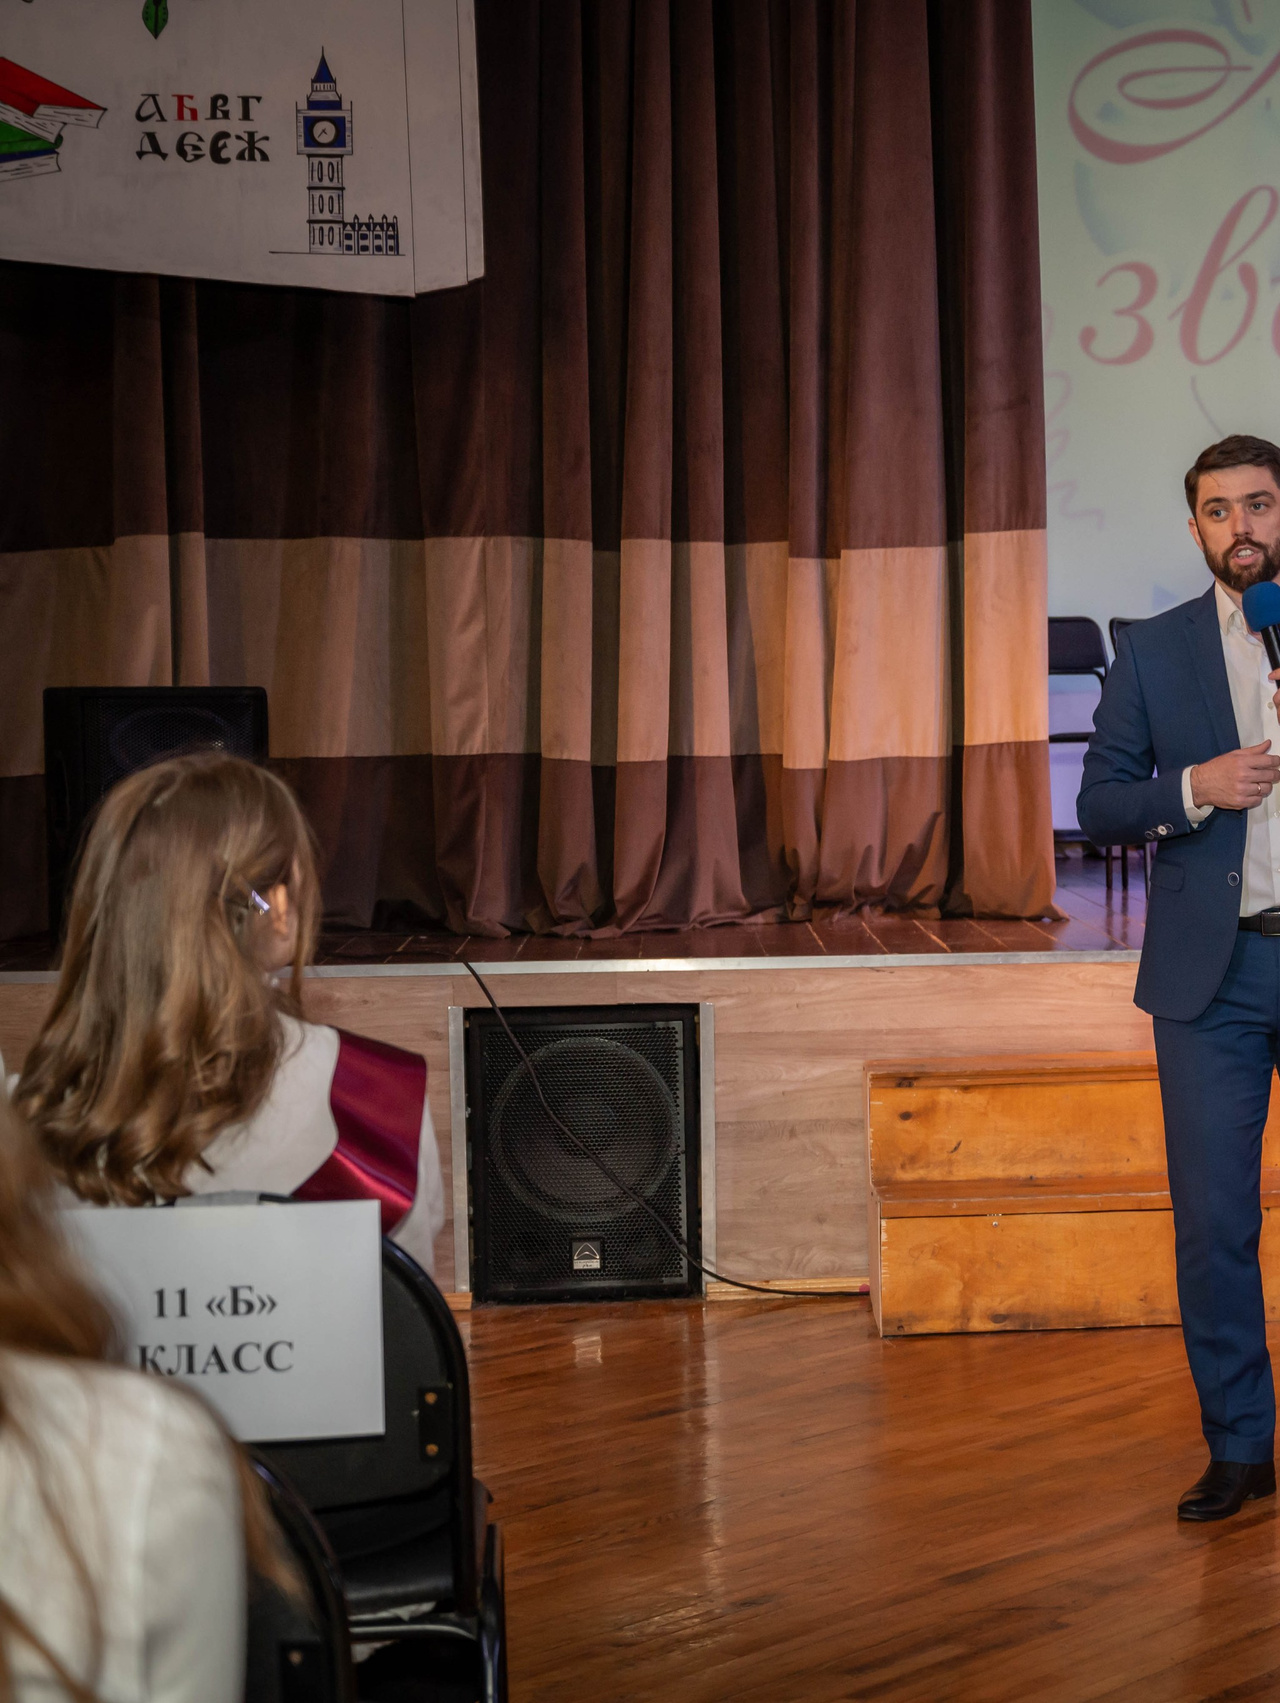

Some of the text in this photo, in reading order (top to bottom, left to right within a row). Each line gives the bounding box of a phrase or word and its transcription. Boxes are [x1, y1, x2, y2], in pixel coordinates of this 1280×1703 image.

[155, 1285, 278, 1318] 11 «Б»
[138, 1340, 294, 1376] КЛАСС
